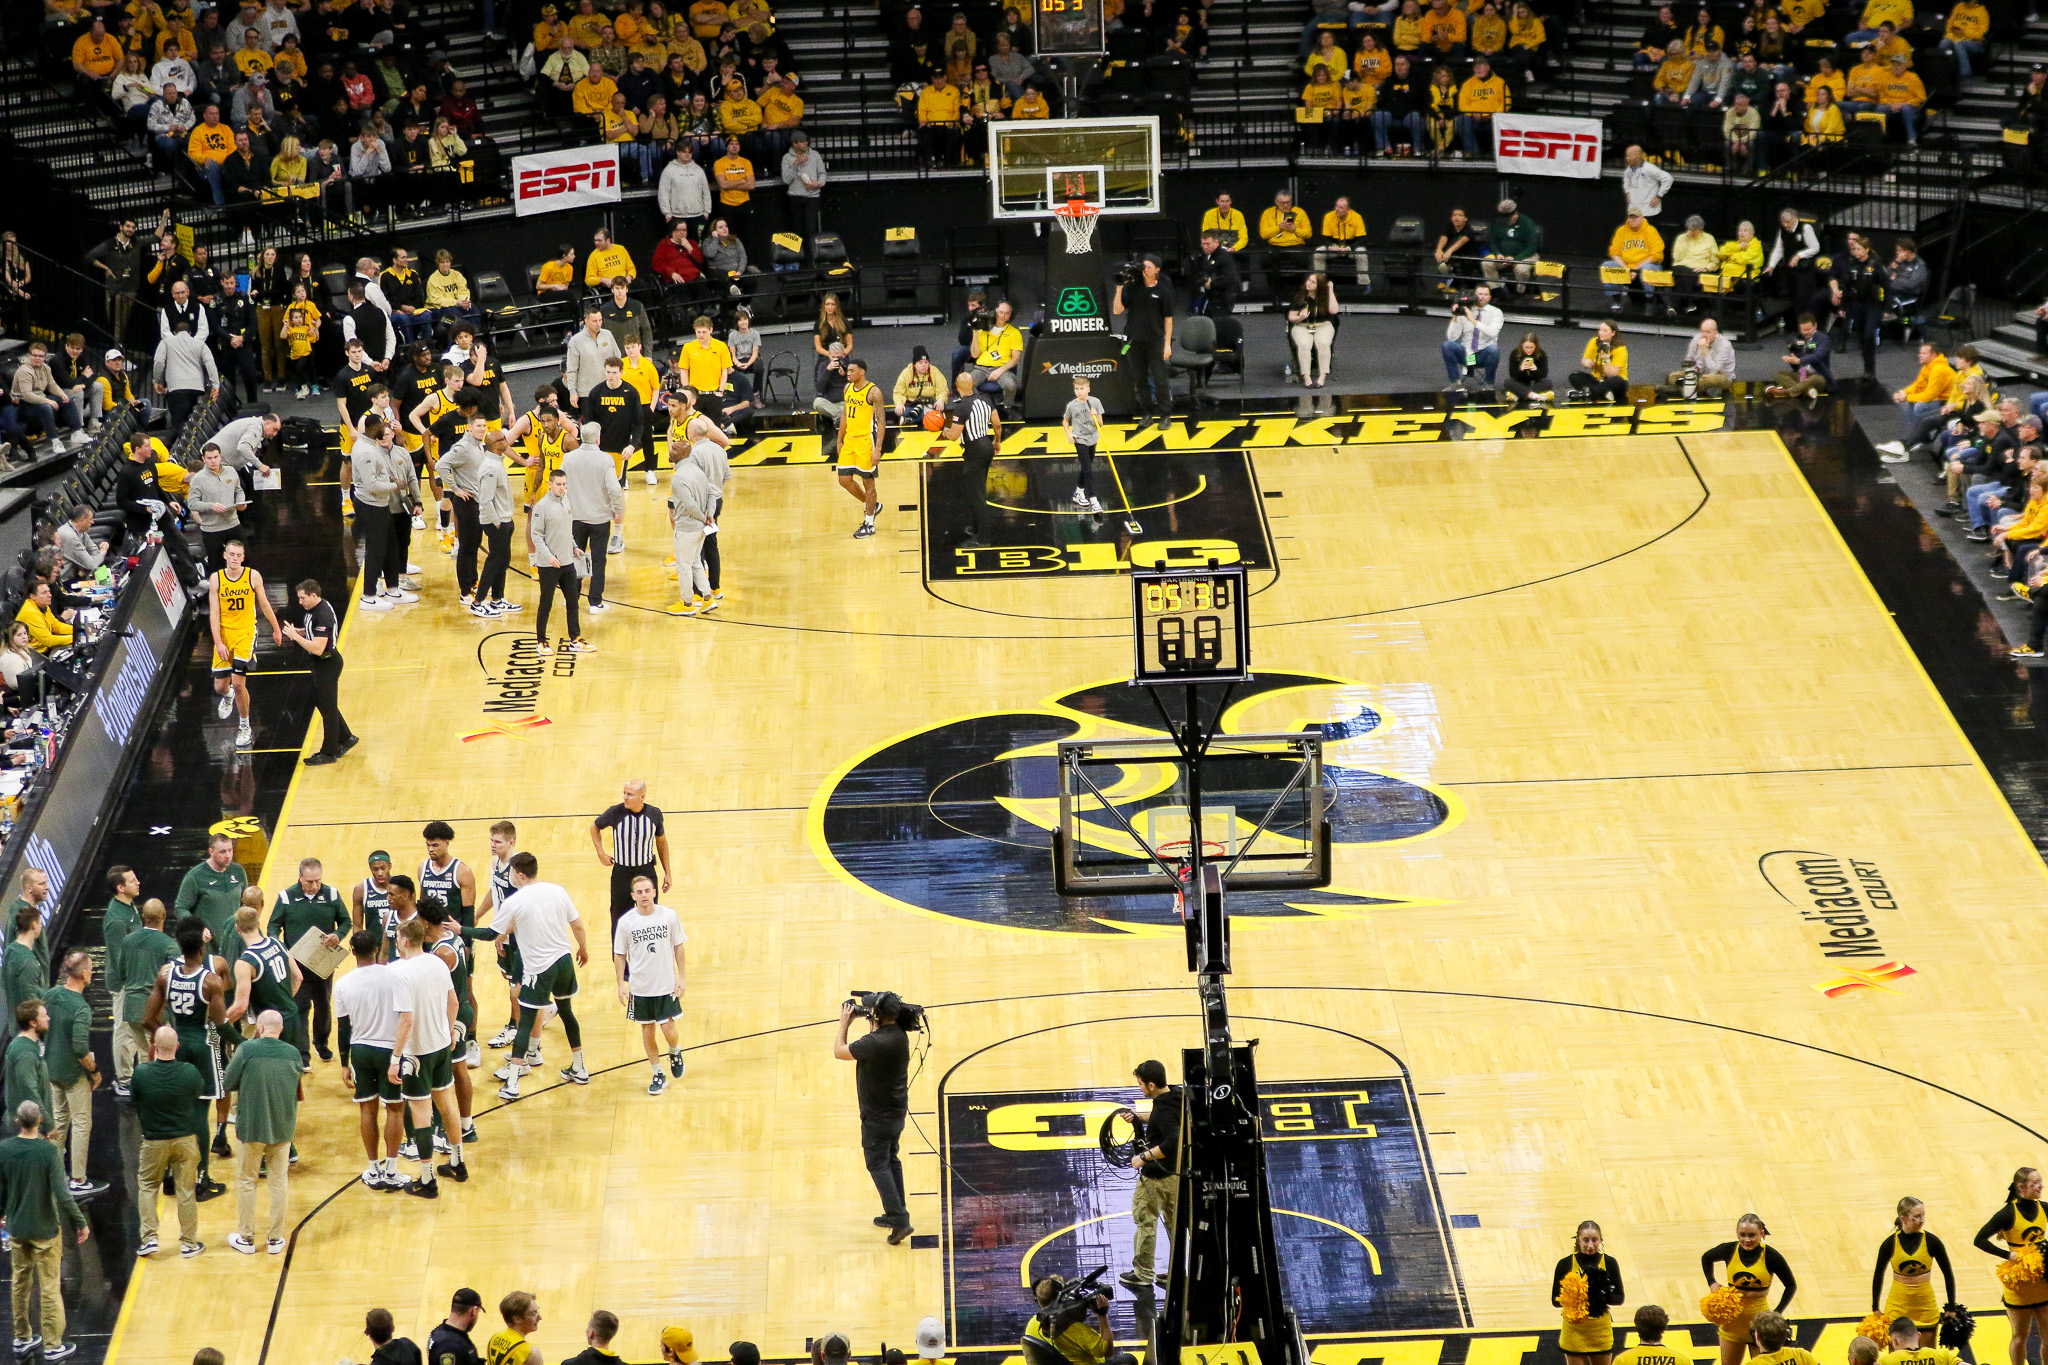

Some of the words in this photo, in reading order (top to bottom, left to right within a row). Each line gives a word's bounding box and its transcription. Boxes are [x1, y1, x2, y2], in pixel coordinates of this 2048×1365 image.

[1472, 87, 1496, 97] IOWA
[1499, 129, 1599, 163] ESPN
[519, 159, 616, 200] ESPN
[1622, 240, 1646, 251] IOWA
[605, 260, 621, 268] STATE
[1051, 317, 1105, 333] PIONEER
[1060, 362, 1113, 374] Mediacom
[350, 374, 372, 387] IOWA
[416, 376, 438, 389] IOWA
[600, 396, 625, 407] IOWA
[847, 405, 856, 419] 11
[1161, 575, 1214, 583] DAKTRONICS
[220, 588, 250, 598] Iowa
[227, 597, 245, 611] 20
[482, 636, 551, 713] Mediacom
[423, 881, 452, 889] SPARTANS
[1848, 858, 1899, 910] COURT
[1795, 857, 1886, 958] Mediacom
[631, 925, 668, 938] SPARTAN
[632, 931, 668, 944] STRONG
[269, 955, 287, 984] 10
[170, 980, 196, 991] SISSOKO
[169, 991, 195, 1016] 22
[1202, 1180, 1249, 1192] SPALDING
[1637, 1356, 1676, 1365] IOWA
